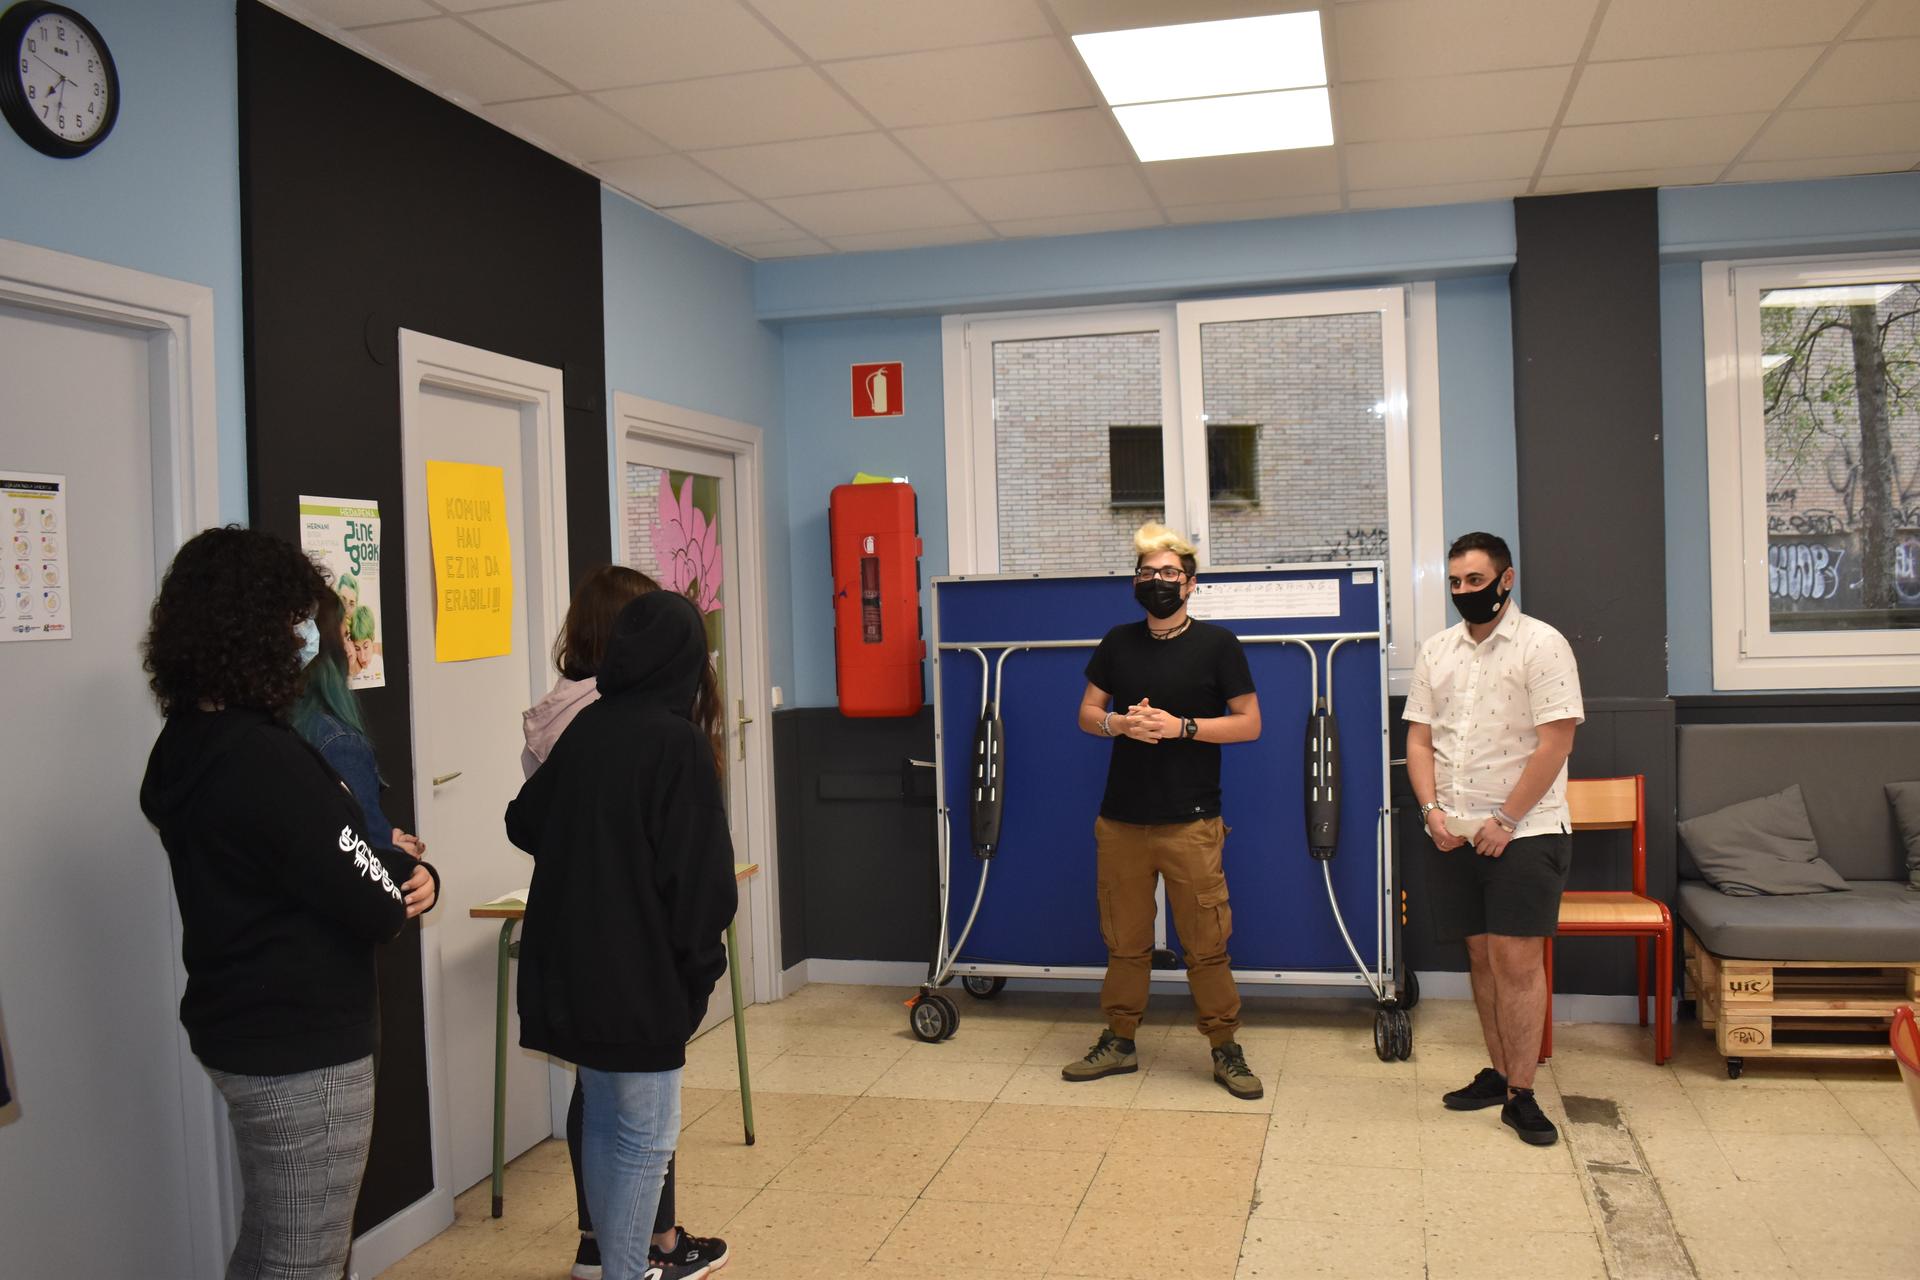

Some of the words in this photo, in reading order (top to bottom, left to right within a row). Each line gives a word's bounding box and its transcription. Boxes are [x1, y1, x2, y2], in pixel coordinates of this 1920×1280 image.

[40, 26, 48, 41] 11
[57, 26, 65, 41] 12
[27, 38, 36, 53] 10
[21, 59, 28, 73] 9
[87, 59, 94, 73] 2
[28, 85, 36, 99] 8
[94, 82, 100, 96] 3
[42, 104, 49, 119] 7
[87, 102, 94, 114] 4
[58, 115, 65, 129] 6
[76, 114, 83, 128] 5
[456, 527, 481, 549] HAU
[445, 556, 480, 578] EZIN
[485, 555, 500, 577] DA
